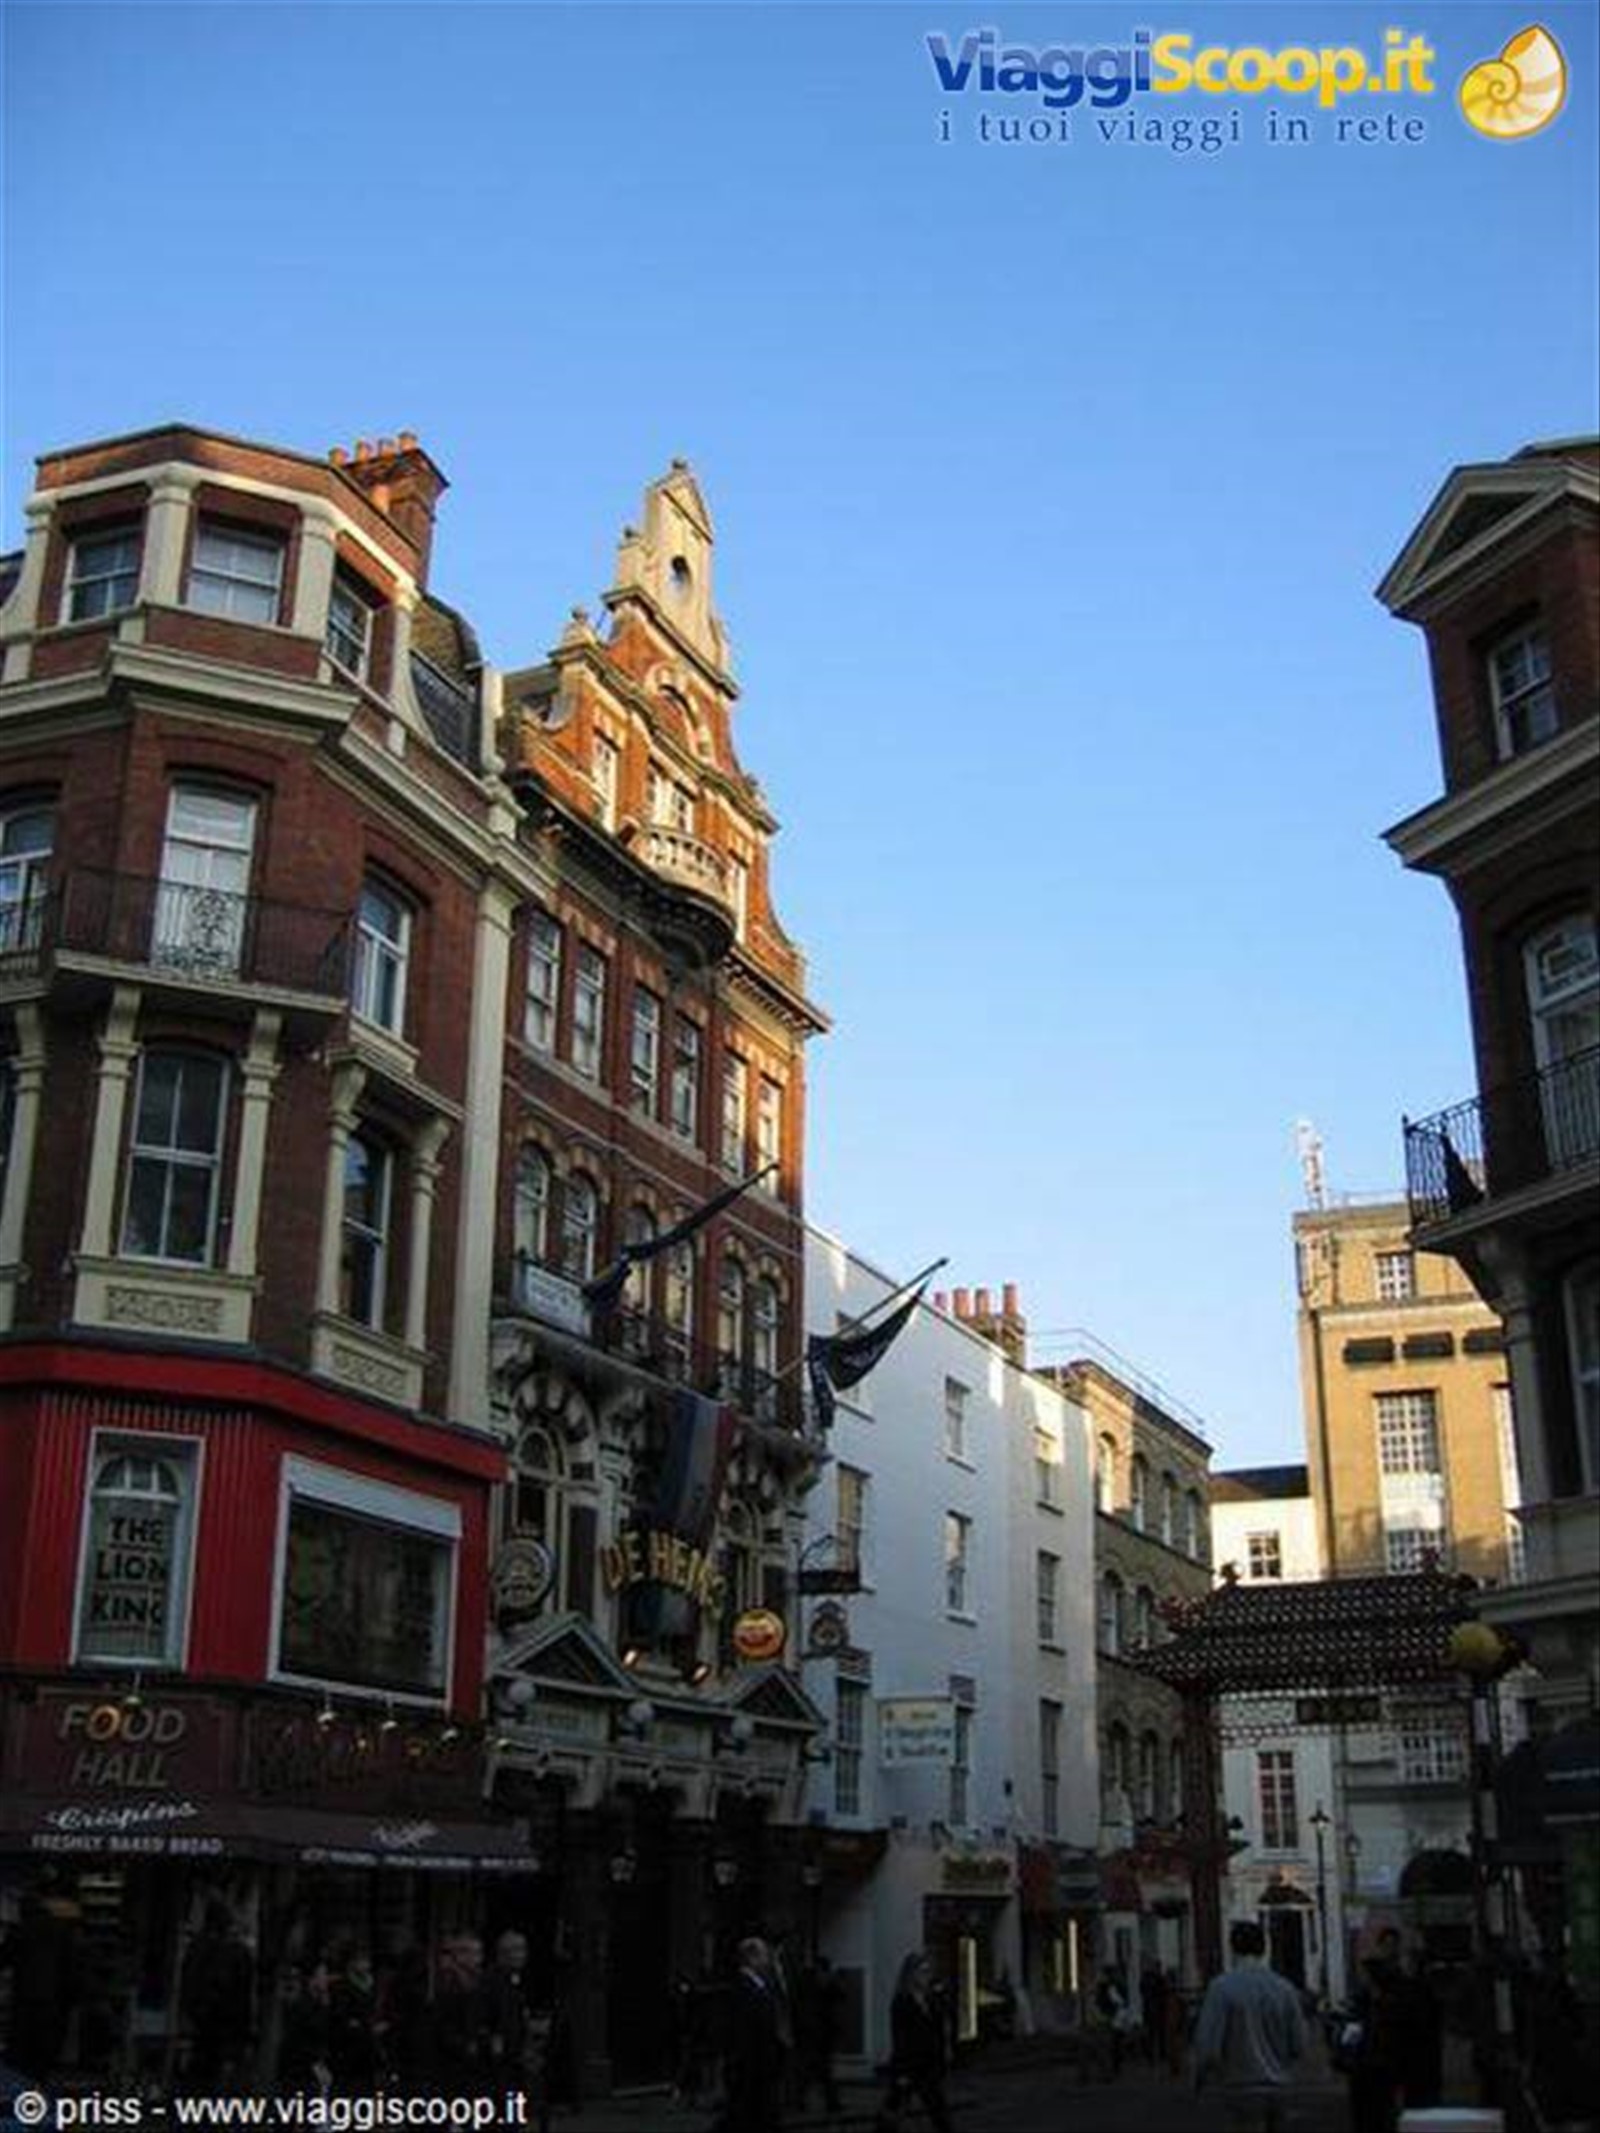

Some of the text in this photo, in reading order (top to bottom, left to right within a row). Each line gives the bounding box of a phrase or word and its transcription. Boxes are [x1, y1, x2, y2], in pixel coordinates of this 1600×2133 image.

[111, 1517, 164, 1544] THE
[97, 1550, 166, 1580] LION
[58, 1704, 185, 1743] FOOD
[70, 1751, 168, 1788] HALL
[169, 1838, 223, 1856] BREAD
